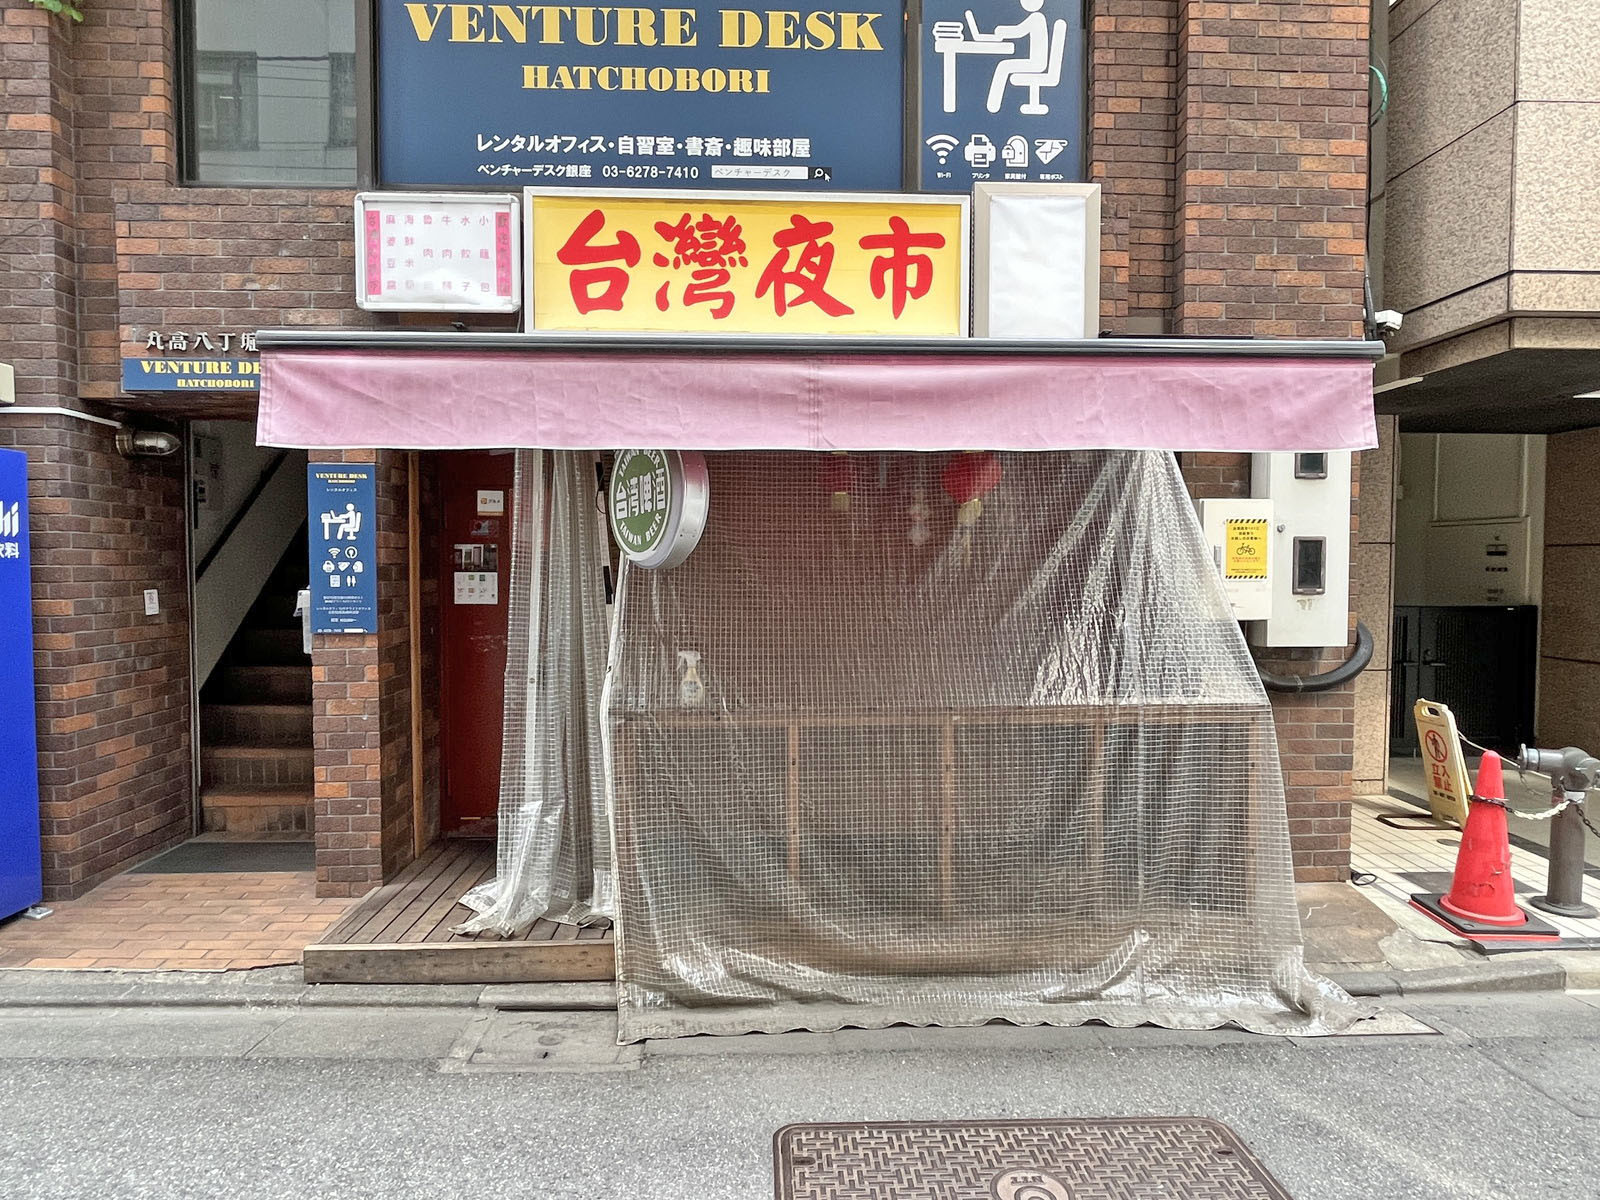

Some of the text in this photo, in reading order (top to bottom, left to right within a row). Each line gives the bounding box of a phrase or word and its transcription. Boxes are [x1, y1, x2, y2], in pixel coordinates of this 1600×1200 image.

[402, 3, 884, 51] VENTURE DESK
[521, 65, 770, 93] HATCHOBORI
[477, 163, 699, 179] ベンチャーデスク銀座 03-6278-7410
[556, 208, 946, 320] 台灣夜市
[141, 360, 232, 375] VENTURE
[176, 379, 255, 388] HATCHOBORI
[619, 512, 662, 546] TAIWAN BEER
